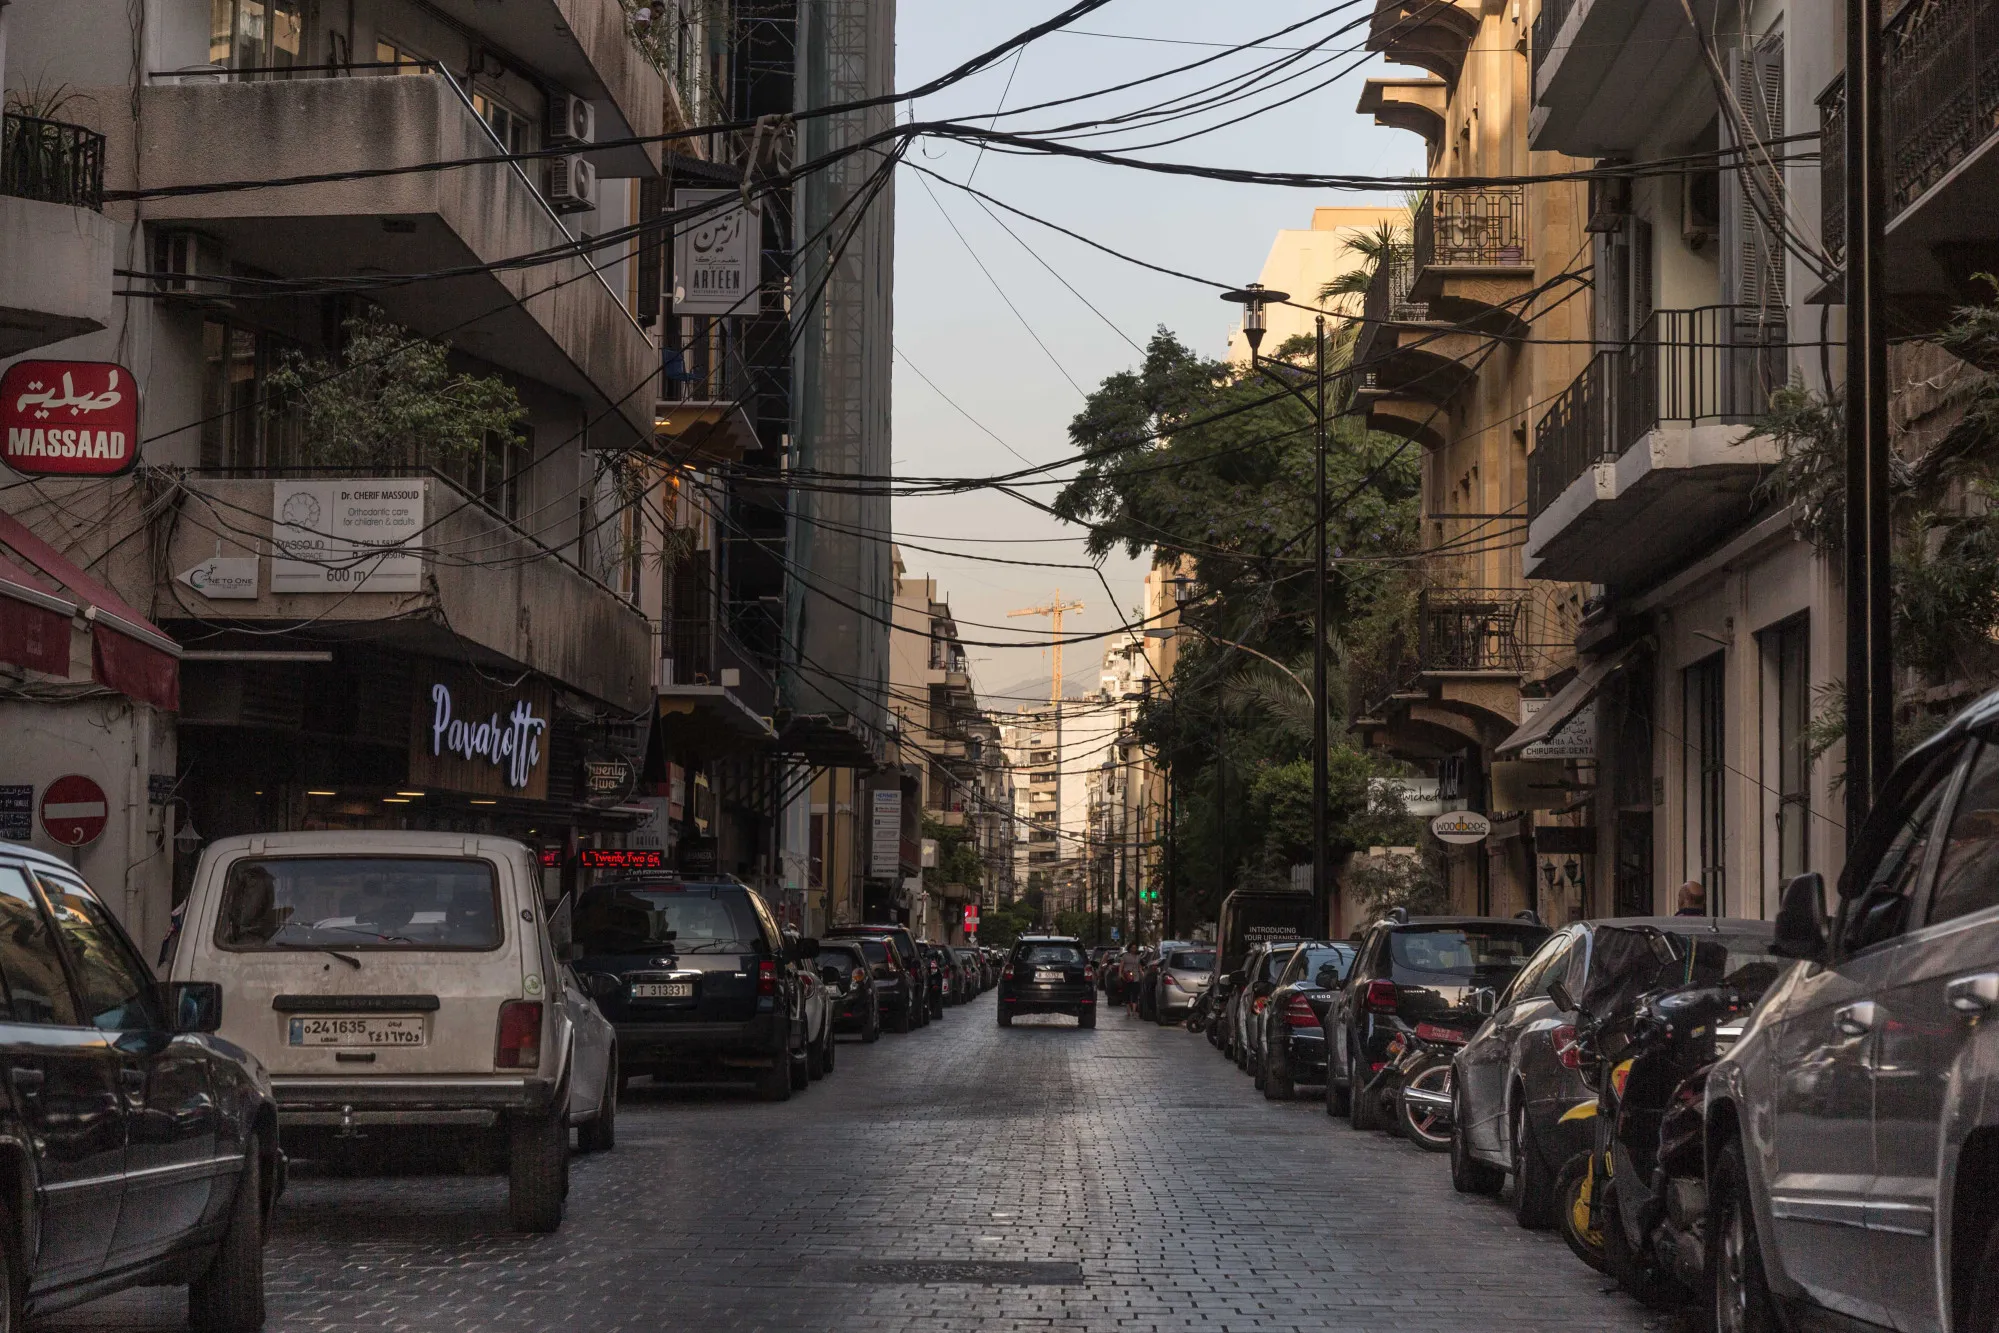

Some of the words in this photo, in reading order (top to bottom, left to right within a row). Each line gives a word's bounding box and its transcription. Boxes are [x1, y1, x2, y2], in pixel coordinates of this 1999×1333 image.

[694, 270, 740, 289] ARTEEN
[8, 427, 125, 459] MASSAAD
[341, 491, 352, 500] Dr.
[354, 491, 380, 500] CHERIF
[381, 490, 419, 500] MASSOUD
[348, 508, 391, 516] Orthodontic
[354, 517, 384, 526] children
[392, 517, 416, 526] adults
[327, 569, 350, 582] 600
[354, 571, 366, 581] m
[432, 683, 546, 787] Pavarotti
[1569, 747, 1594, 755] DENTA
[585, 758, 628, 783] Twenty
[593, 853, 625, 865] Twenty
[627, 853, 645, 863] Two
[1249, 926, 1297, 934] INTRODUCING
[650, 986, 687, 995] 313331
